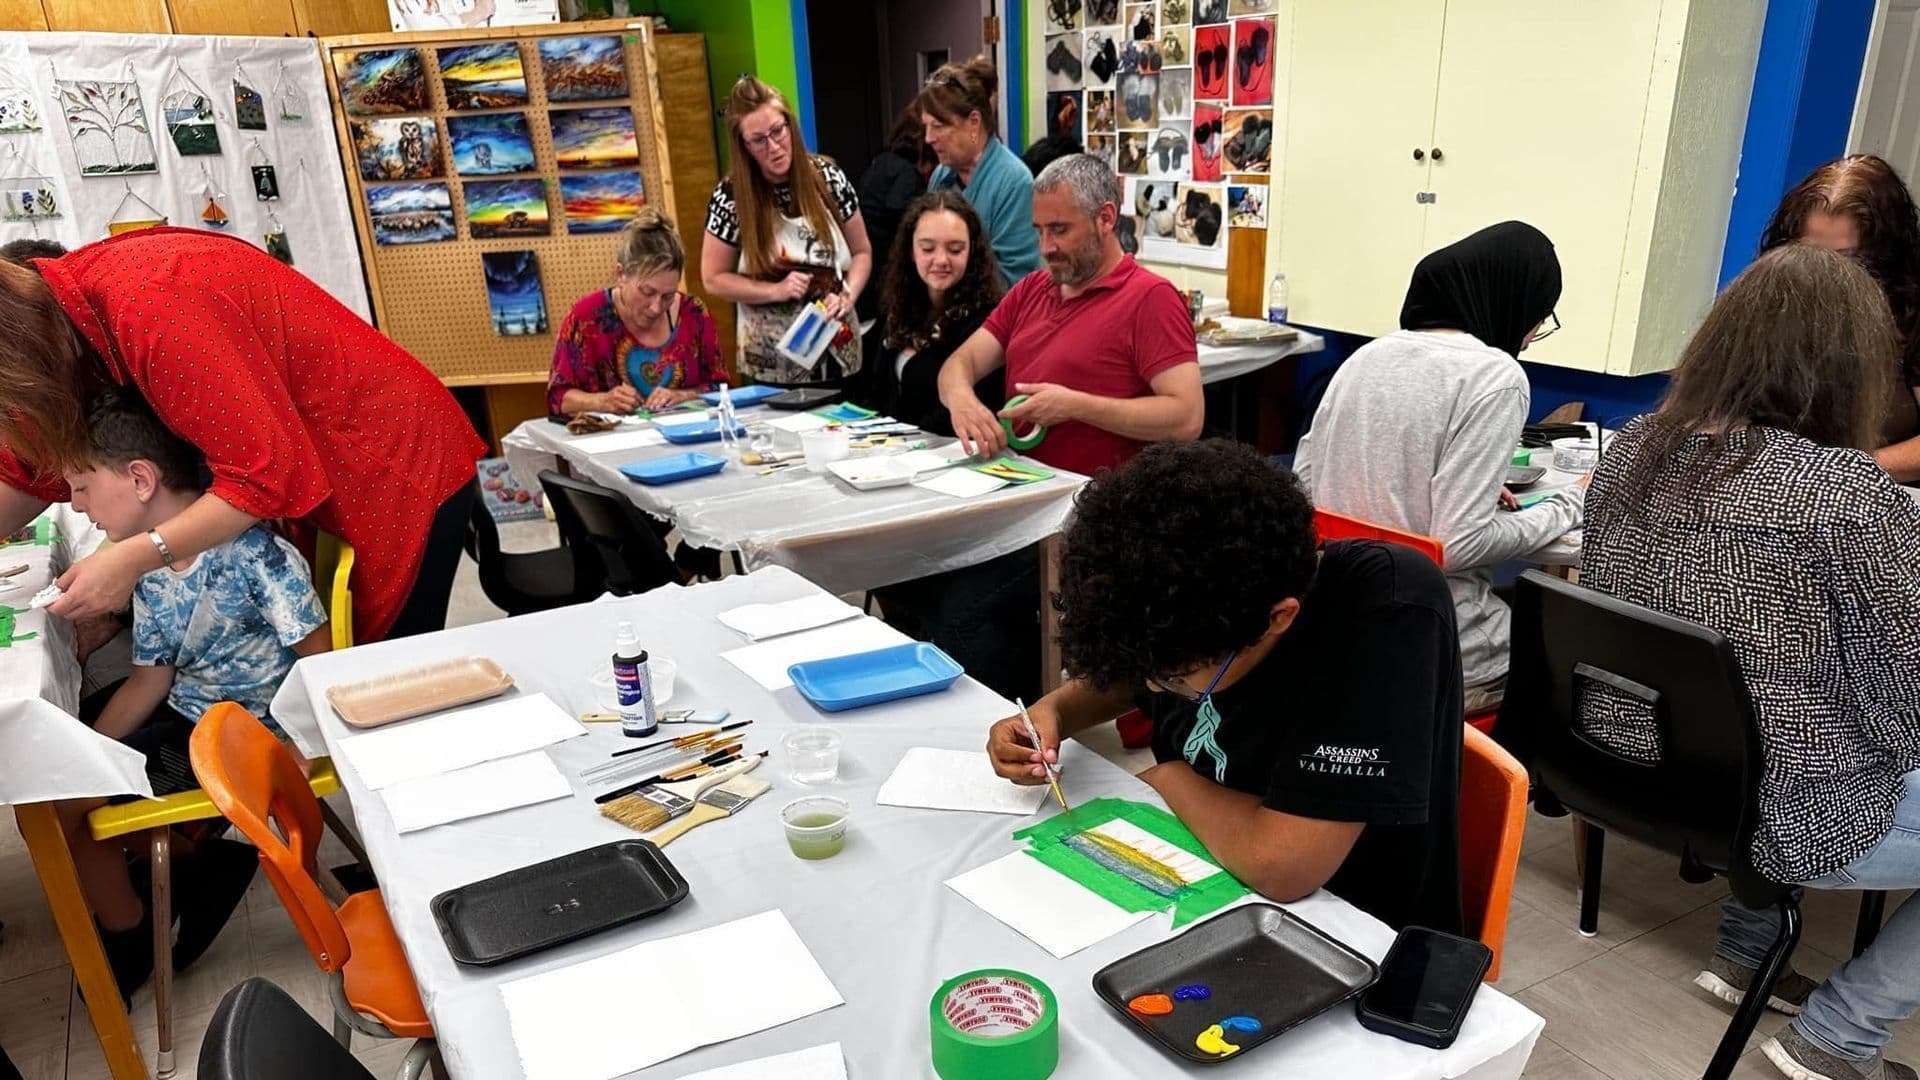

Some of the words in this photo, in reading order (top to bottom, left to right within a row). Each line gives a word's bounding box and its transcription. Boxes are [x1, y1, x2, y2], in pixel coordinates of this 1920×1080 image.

[1329, 755, 1362, 764] CREED
[1299, 759, 1385, 777] VALHALLA
[969, 986, 1001, 997] DURAMAX
[980, 996, 1012, 1004] DURAMAX
